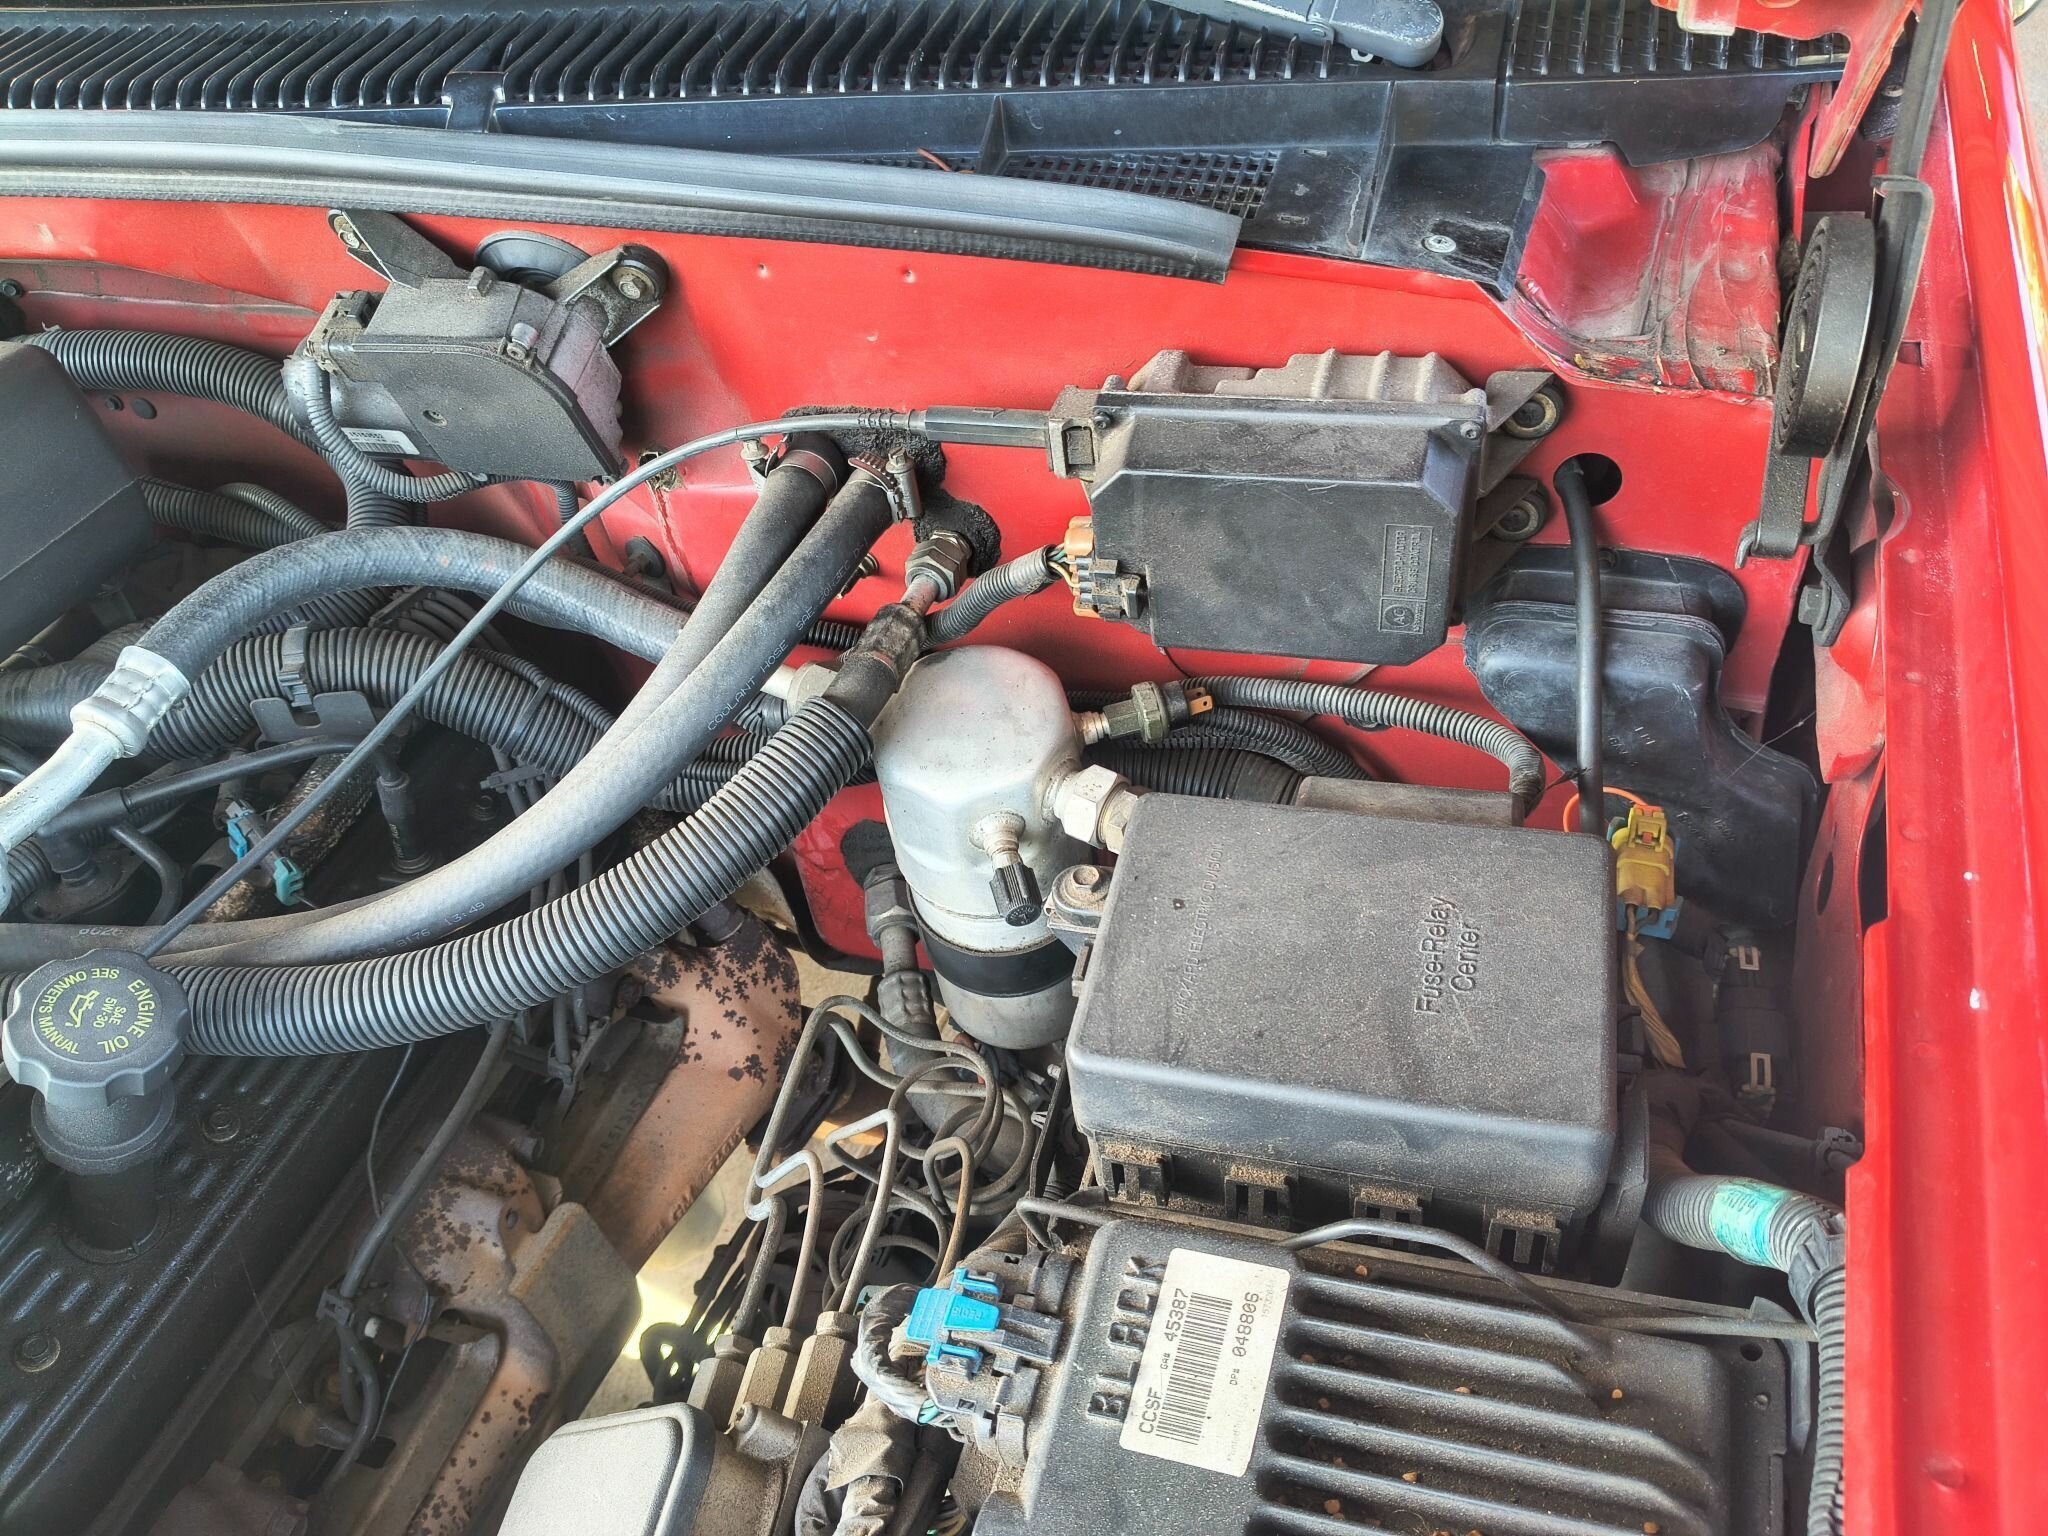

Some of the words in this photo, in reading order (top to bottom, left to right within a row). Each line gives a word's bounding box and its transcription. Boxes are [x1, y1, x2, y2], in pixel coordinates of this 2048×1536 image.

[707, 675, 758, 732] COOLANT
[760, 639, 789, 674] HOSE
[795, 605, 816, 631] SAE
[1188, 895, 1214, 952] ELECTRIC
[90, 967, 120, 979] SEE
[1413, 896, 1458, 1014] Fuse-Relay
[1449, 920, 1481, 993] Center
[38, 1015, 79, 1055] MANUAL
[92, 996, 117, 1028] 5W-30
[108, 1006, 127, 1025] SAE
[127, 979, 156, 1039] ENGINE
[97, 1035, 129, 1054] OIL
[1232, 1291, 1260, 1358] 048806
[1138, 1387, 1163, 1434] CCSF
[1164, 1287, 1189, 1342] 45387
